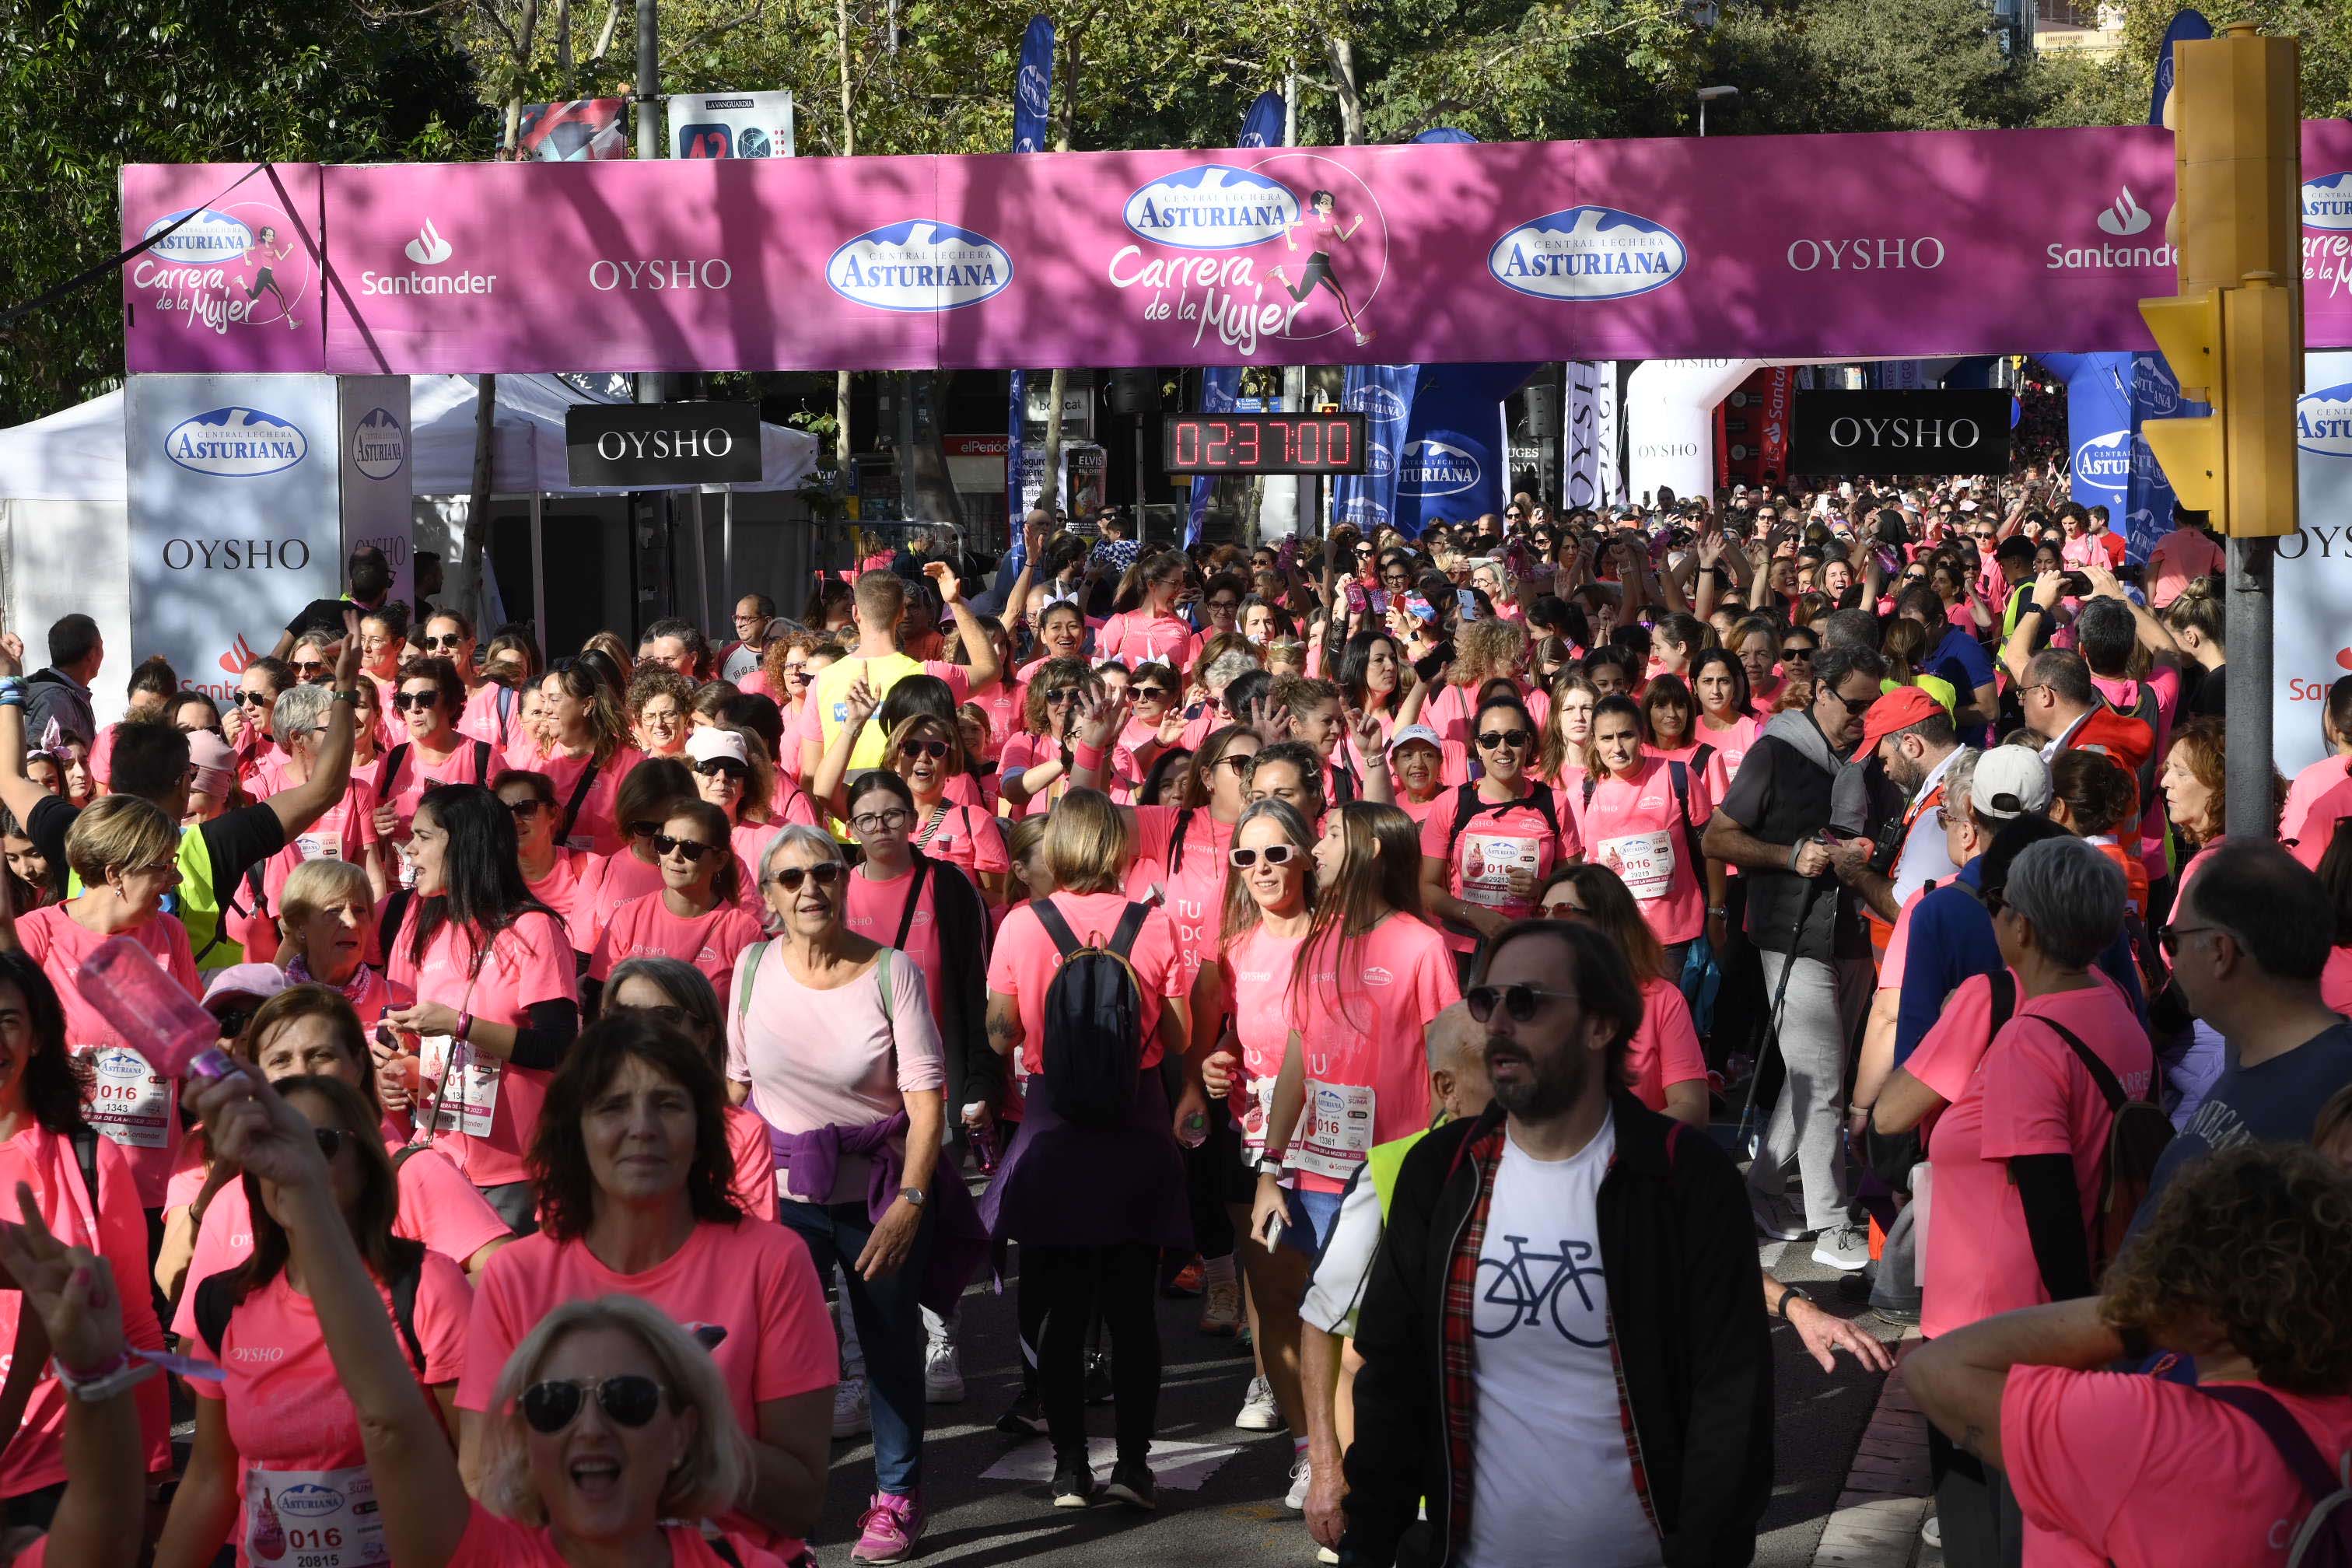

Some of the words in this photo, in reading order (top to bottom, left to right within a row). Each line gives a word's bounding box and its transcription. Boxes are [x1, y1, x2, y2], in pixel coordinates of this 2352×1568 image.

[1164, 194, 1220, 203] CENTRAL
[1225, 193, 1281, 202] LECHERA
[1139, 197, 1285, 228] ASTURIANA
[1535, 239, 1595, 249] CENTRAL
[1601, 237, 1664, 247] LECHERA
[1788, 236, 1945, 271] OYSHO
[870, 250, 927, 260] CENTRAL
[933, 250, 992, 259] LECHERA
[1503, 243, 1671, 277] ASTURIANA
[134, 260, 224, 289] Carrera
[589, 259, 732, 290] OYSHO
[841, 254, 998, 289] ASTURIANA
[1109, 245, 1250, 289] Carrera
[2319, 257, 2333, 280] la
[362, 270, 497, 295] Santander
[156, 290, 174, 310] de
[177, 291, 189, 310] la
[187, 286, 259, 334] Mujer
[1145, 290, 1171, 320] de
[1177, 289, 1196, 320] la
[1193, 286, 1307, 356] Mujer
[1570, 362, 1594, 508] OYSH
[1830, 416, 1979, 449] OYSHO
[2297, 411, 2352, 438] ASTU
[176, 433, 297, 460] ASTURIANA
[357, 436, 401, 462] ASTURIANA
[598, 428, 732, 460] OYSHO
[1176, 422, 1351, 465] 02:37:00
[1639, 443, 1697, 458] OYSHO
[1079, 456, 1102, 466] ELVIS
[1398, 467, 1472, 482] TURIANA
[163, 539, 310, 570] OYSHO
[733, 665, 759, 680] BOS
[1466, 820, 1494, 828] YSHO
[1626, 859, 1650, 870] 016
[1178, 899, 1201, 919] TU
[632, 943, 666, 956] OYSHO
[101, 1063, 142, 1074] ASTURIANA
[100, 1085, 138, 1101] 016
[106, 1103, 128, 1113] 1343
[1318, 1118, 1339, 1134] 016
[1319, 1136, 1335, 1146] 13361
[282, 1497, 339, 1510] ASTURIANA
[289, 1528, 342, 1549] 016
[297, 1554, 340, 1567] 20815
